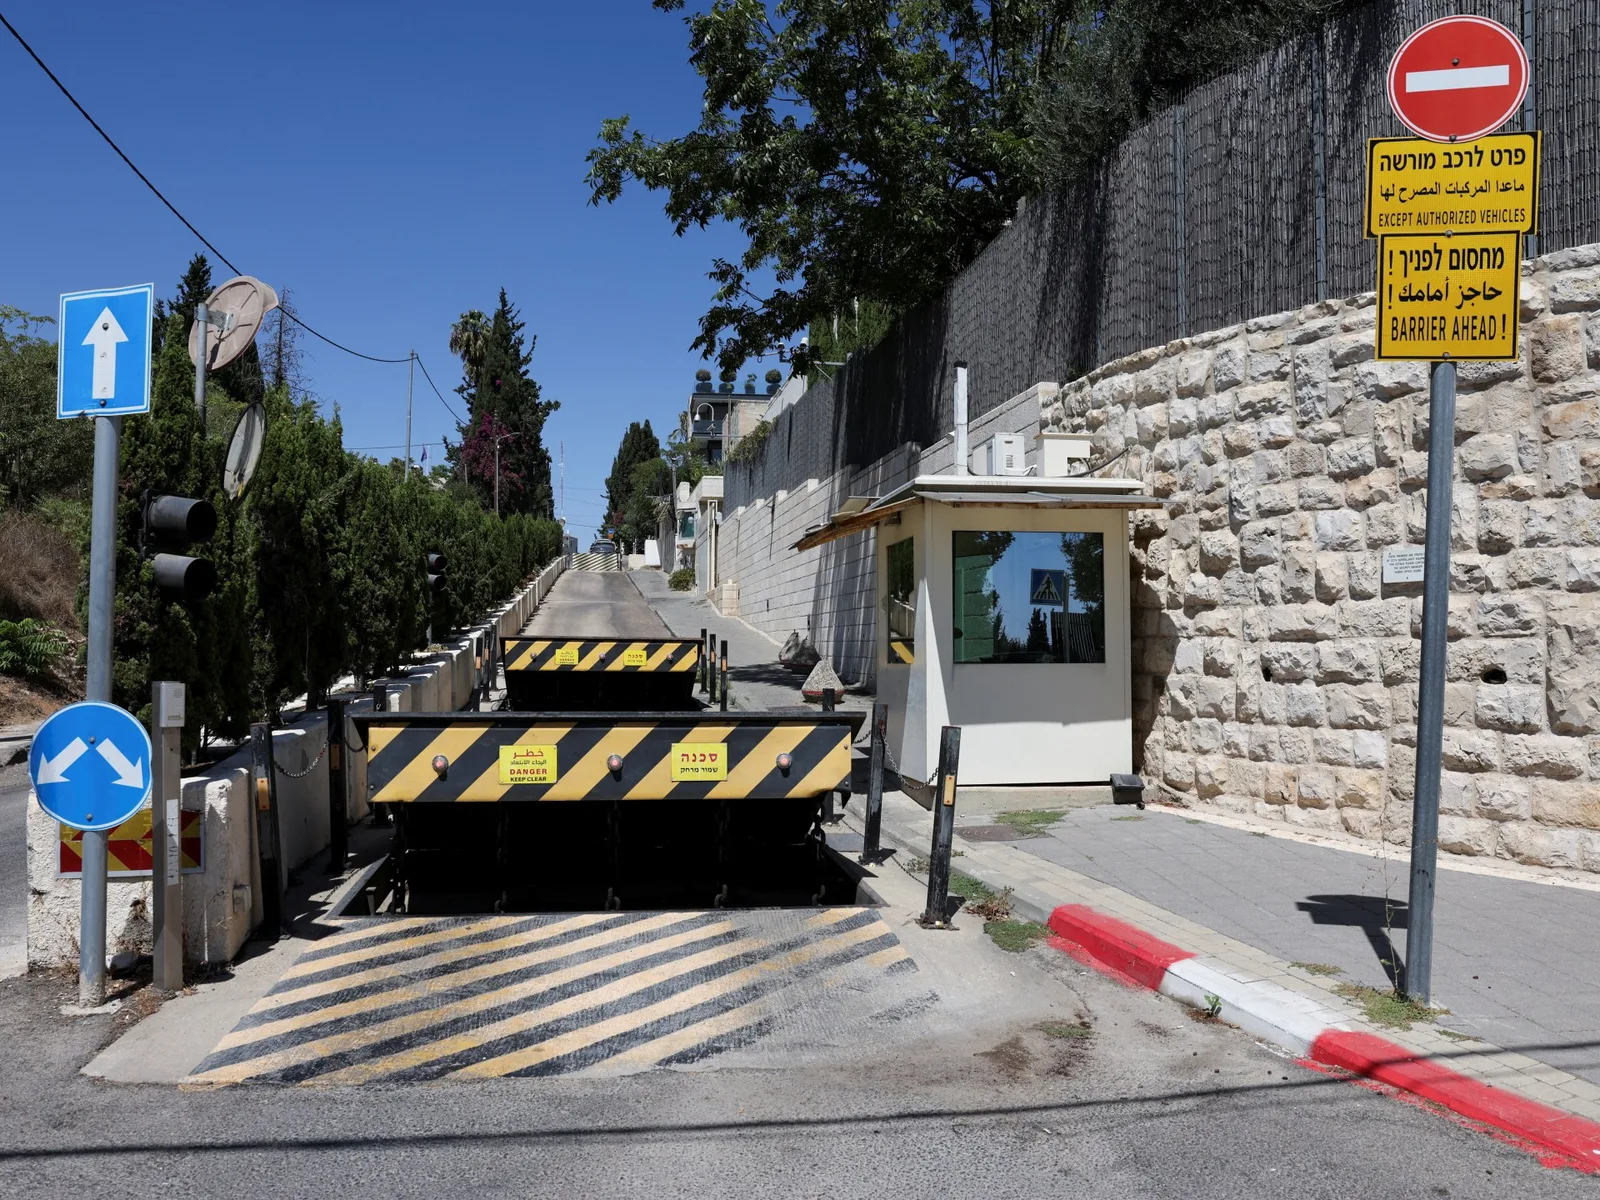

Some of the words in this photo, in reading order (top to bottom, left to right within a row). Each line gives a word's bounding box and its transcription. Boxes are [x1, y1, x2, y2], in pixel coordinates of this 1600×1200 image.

[1380, 152, 1436, 172] מורשה
[1442, 145, 1484, 169] לרכב
[1490, 148, 1526, 167] פרט
[1380, 183, 1395, 201] لها
[1398, 181, 1441, 203] المصرح
[1445, 180, 1491, 198] المركبات
[1378, 212, 1413, 227] EXCEPT
[1416, 210, 1477, 226] AUTHORIZED
[1480, 208, 1526, 224] VEHICLES
[1449, 246, 1505, 271] מחסום
[1455, 280, 1503, 310] حاجز
[1391, 315, 1447, 342] BARRIER
[513, 748, 544, 759] خطر
[680, 752, 718, 763] סכנה
[509, 768, 548, 776] DANGER
